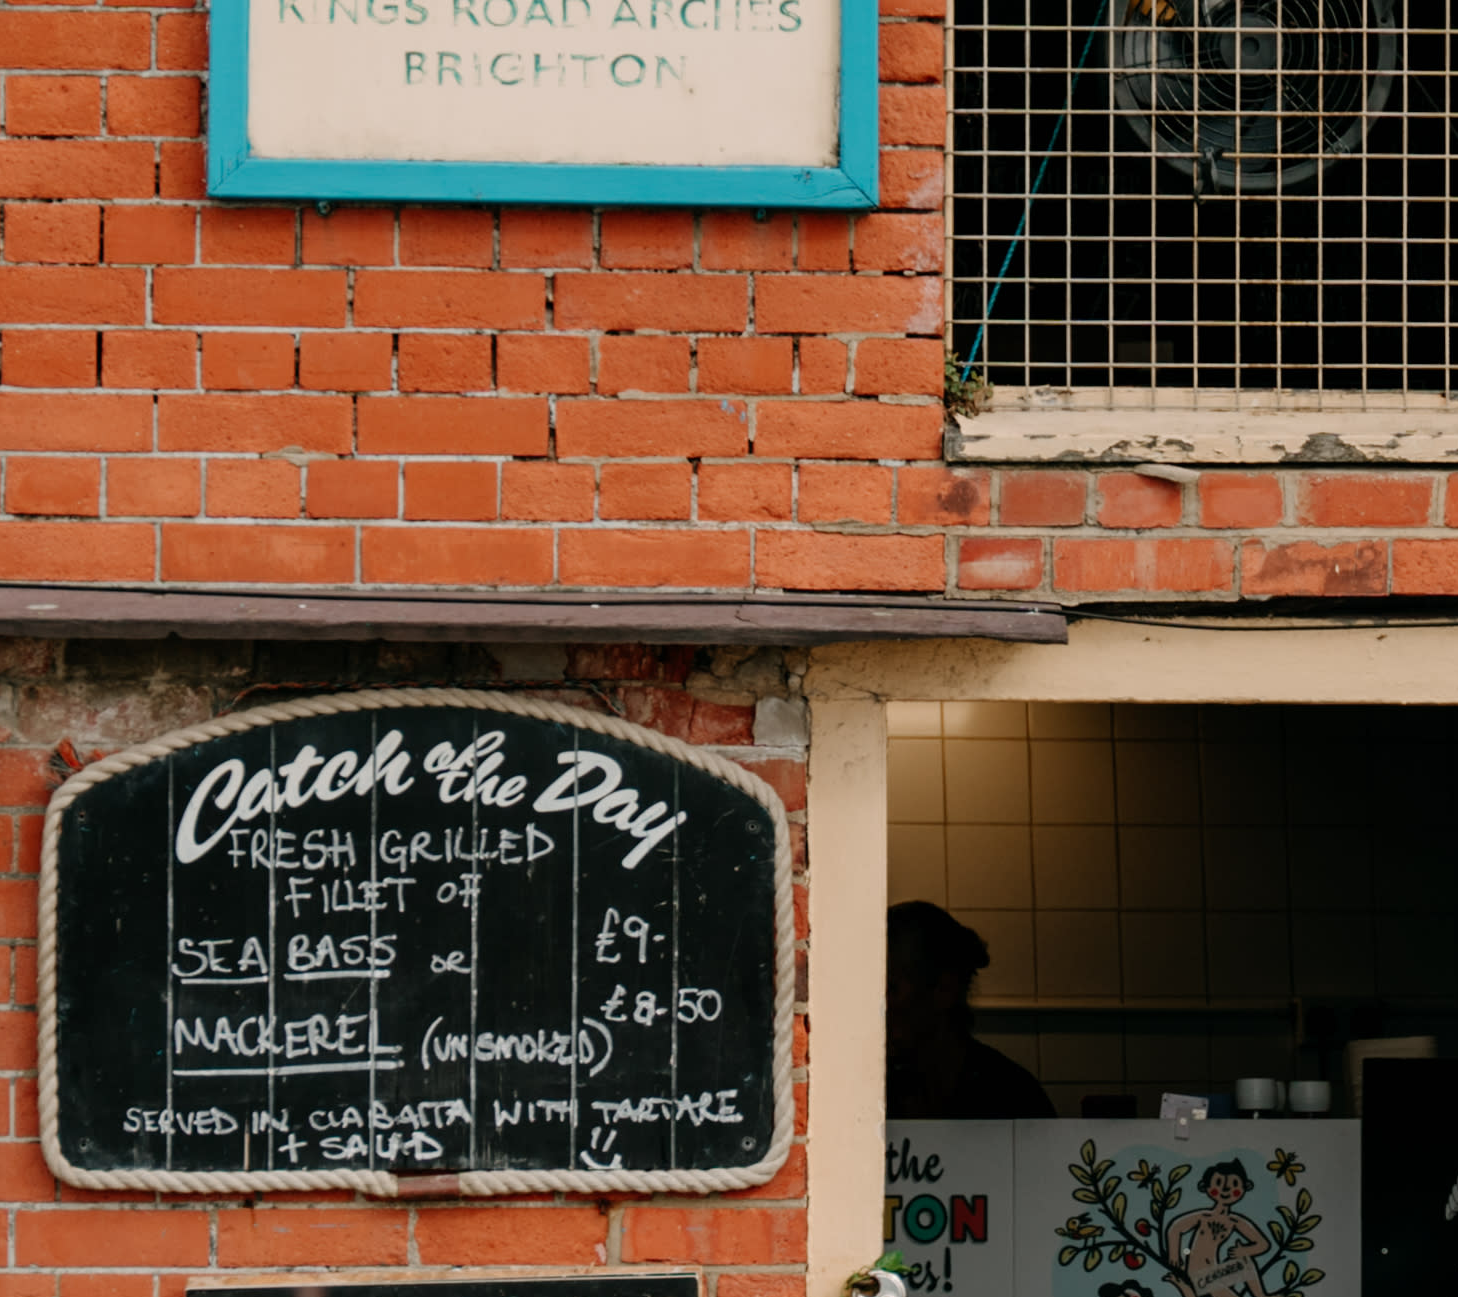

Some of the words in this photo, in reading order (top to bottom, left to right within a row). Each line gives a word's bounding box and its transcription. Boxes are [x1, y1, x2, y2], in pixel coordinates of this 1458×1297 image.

[405, 52, 688, 87] BRIGHTON
[176, 730, 414, 863] Catch
[438, 756, 525, 804] the
[534, 750, 686, 869] Day
[228, 829, 355, 869] FRESH
[379, 823, 555, 865] GRILLED
[284, 878, 416, 917] FILLET
[172, 937, 267, 976] SEA
[287, 935, 396, 971] BASS
[175, 1013, 401, 1056] MACKEREL
[421, 1016, 612, 1076] (UNSMOKED)
[123, 1108, 238, 1135] SERVED
[251, 1109, 289, 1134] IN
[494, 1101, 575, 1127] WITH
[592, 1090, 743, 1125] TARTARE
